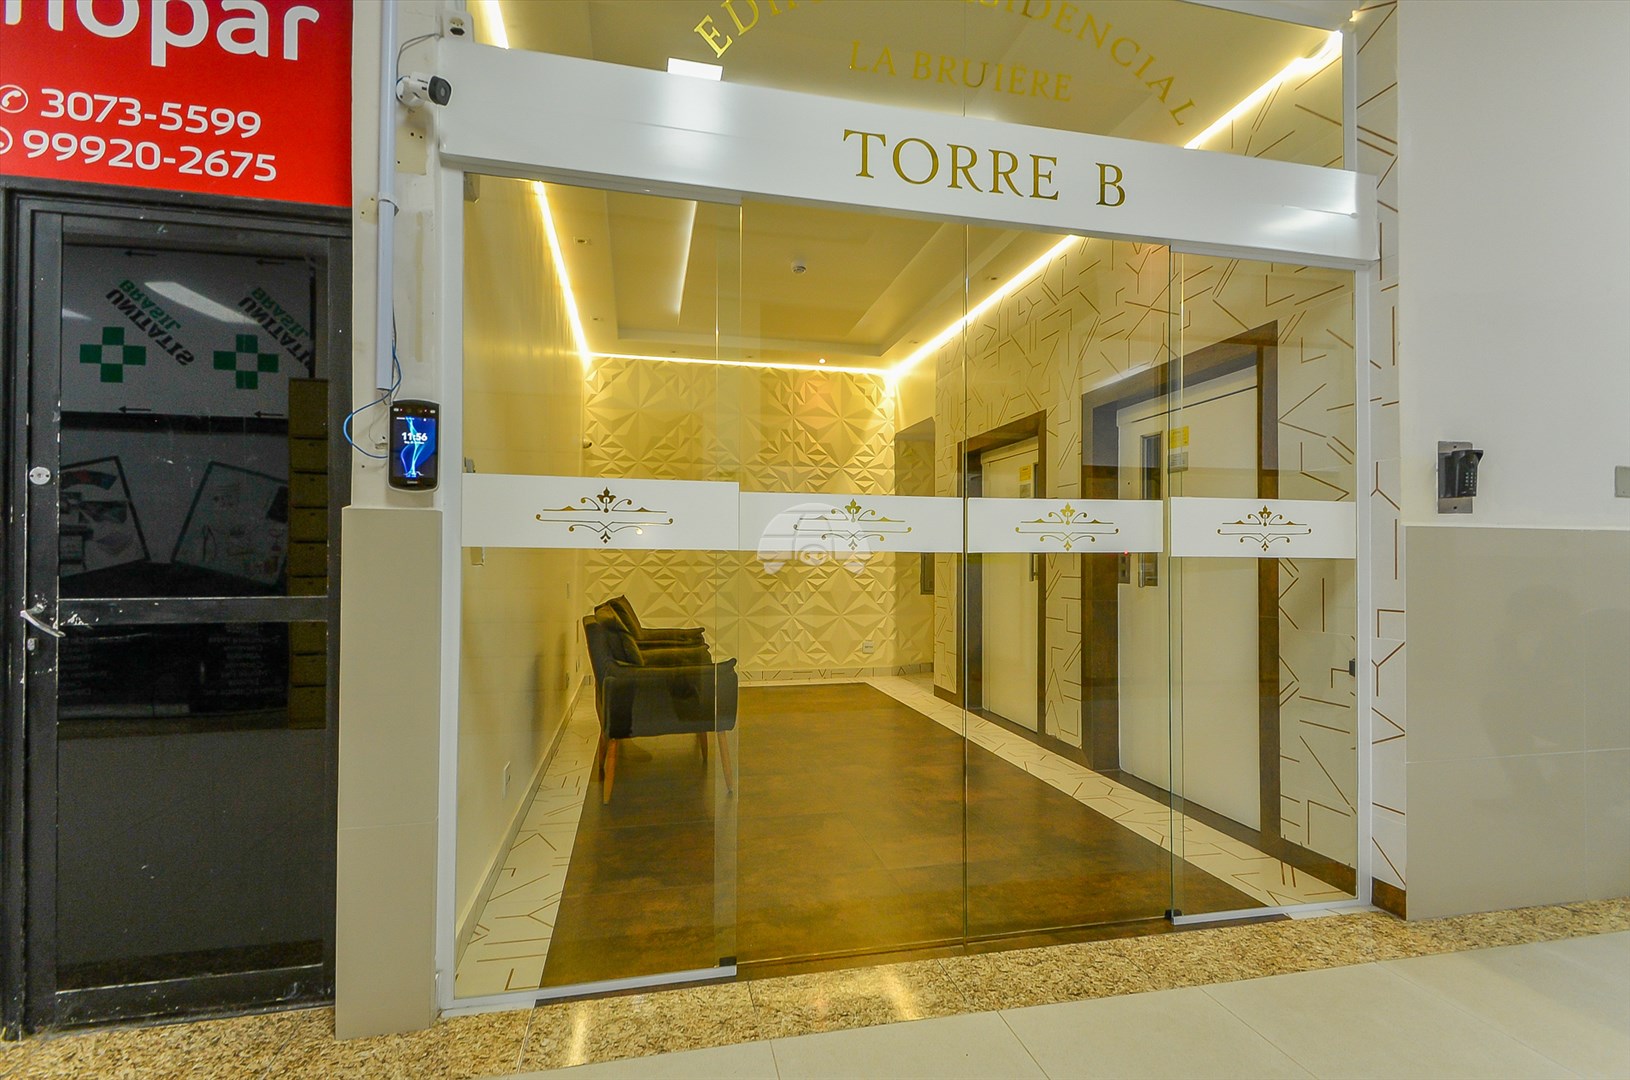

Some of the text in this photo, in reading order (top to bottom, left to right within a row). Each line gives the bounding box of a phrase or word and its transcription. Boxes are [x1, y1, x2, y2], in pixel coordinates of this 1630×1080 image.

[850, 39, 897, 76] LA
[40, 88, 262, 139] 3073-5599
[22, 129, 277, 182] 99920-2675
[843, 129, 1127, 208] TORRE B
[401, 431, 428, 442] 11:56
